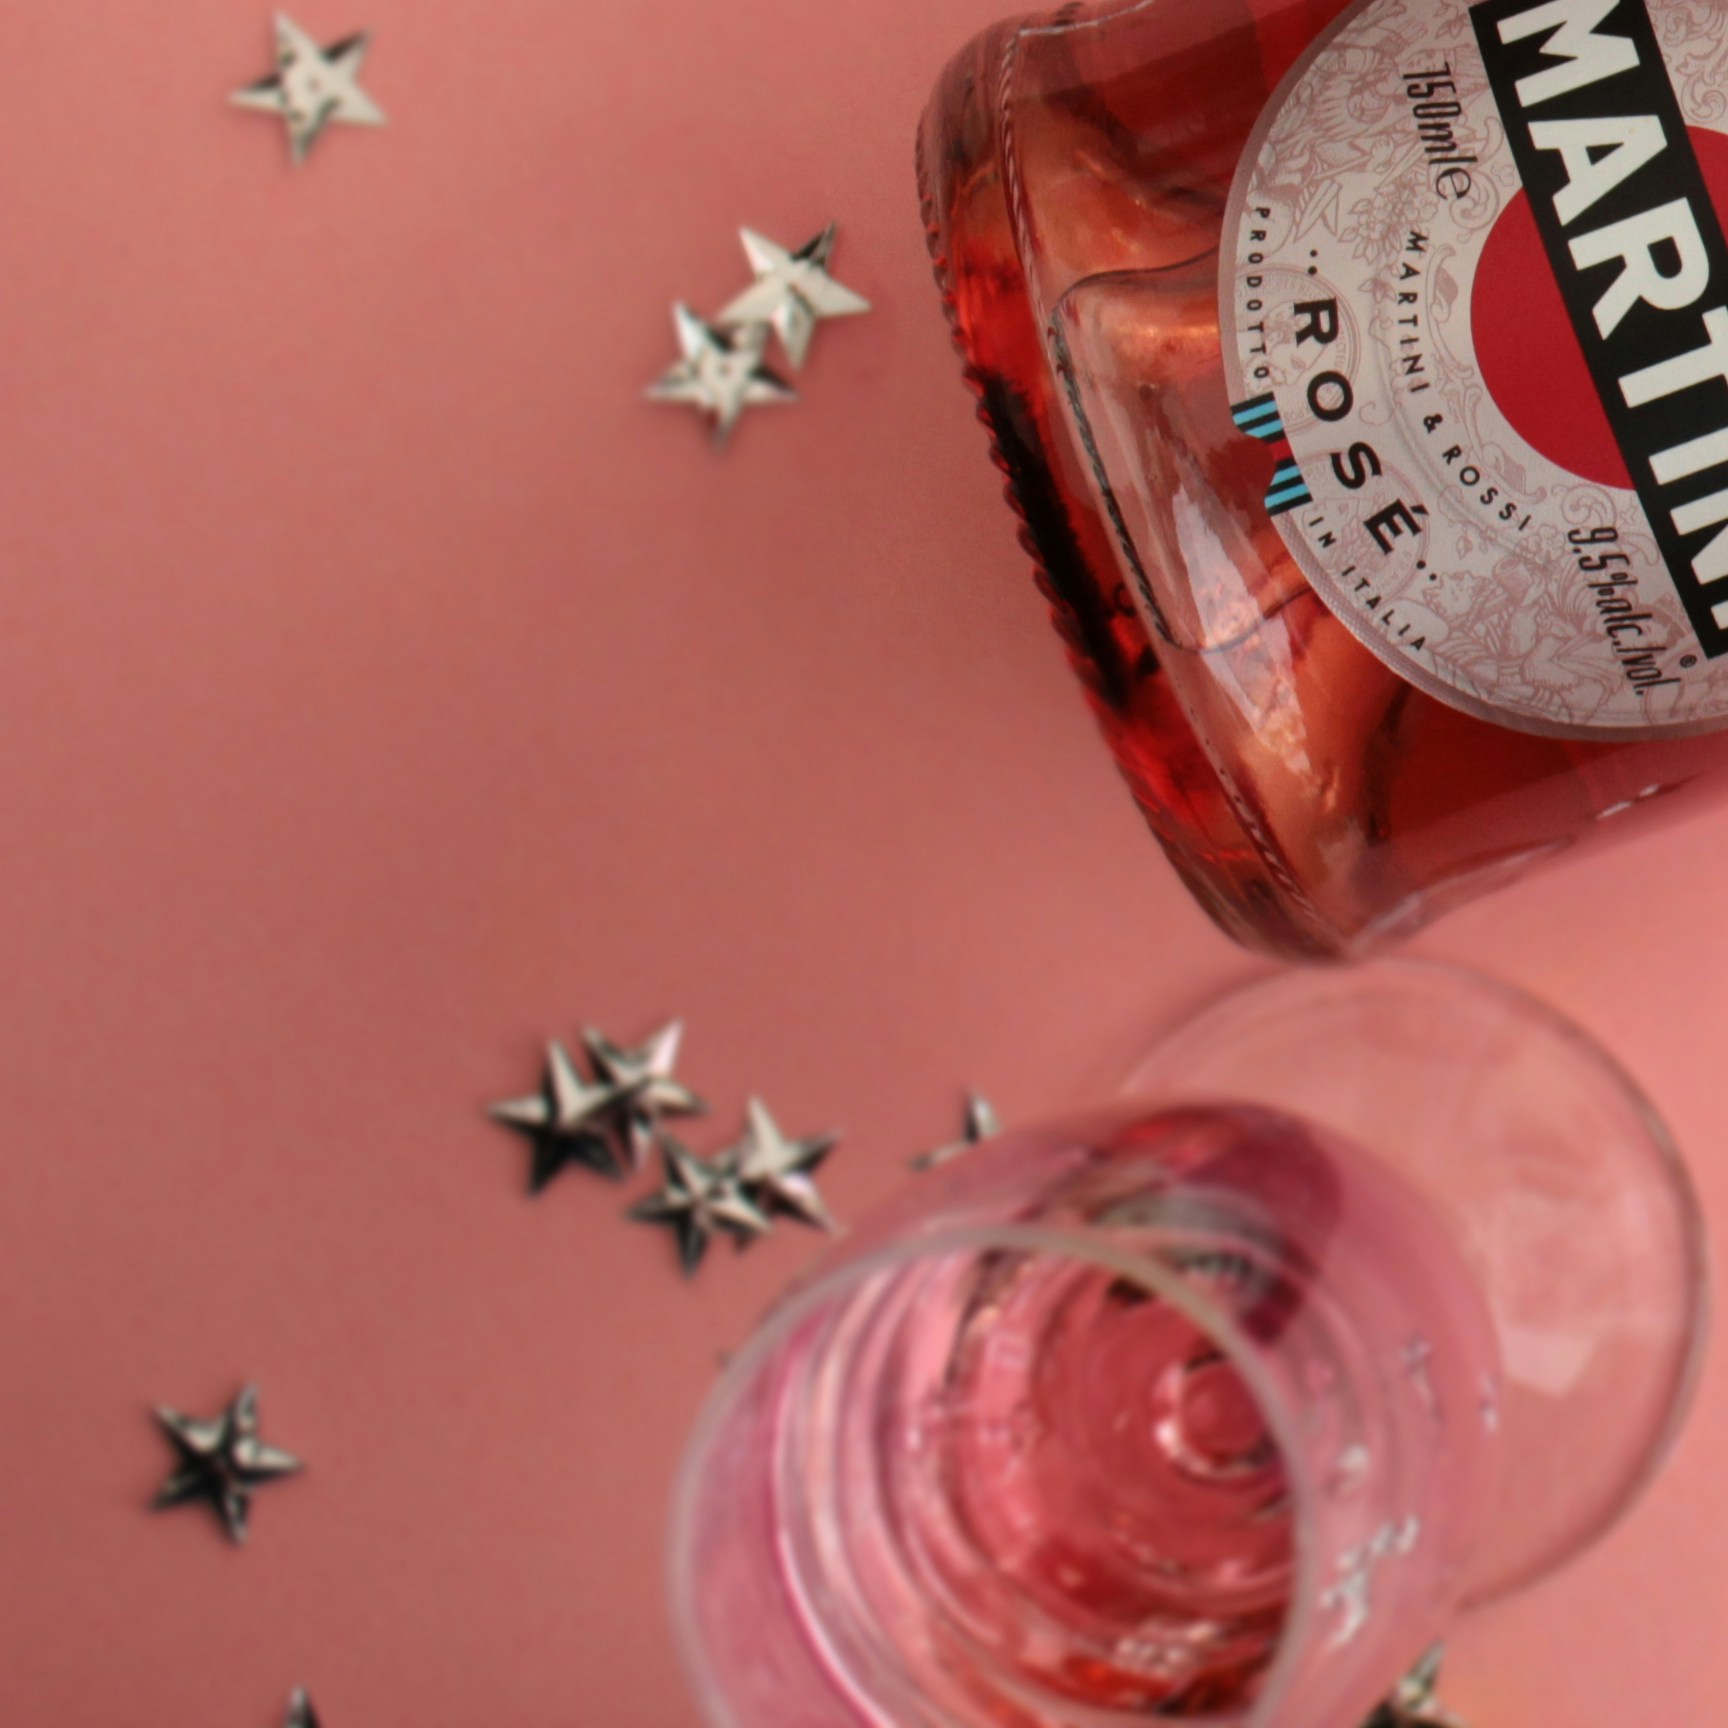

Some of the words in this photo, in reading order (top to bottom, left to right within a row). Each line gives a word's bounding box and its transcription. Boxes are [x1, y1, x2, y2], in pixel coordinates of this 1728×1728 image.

[1247, 206, 1271, 380] PRODOTTO
[1397, 230, 1431, 395] MARTINI
[1422, 412, 1444, 434] &
[1442, 445, 1532, 532] ROSSI
[1293, 295, 1430, 555] ROSÉ
[1308, 515, 1337, 549] IN
[1341, 565, 1426, 652] ITALIA
